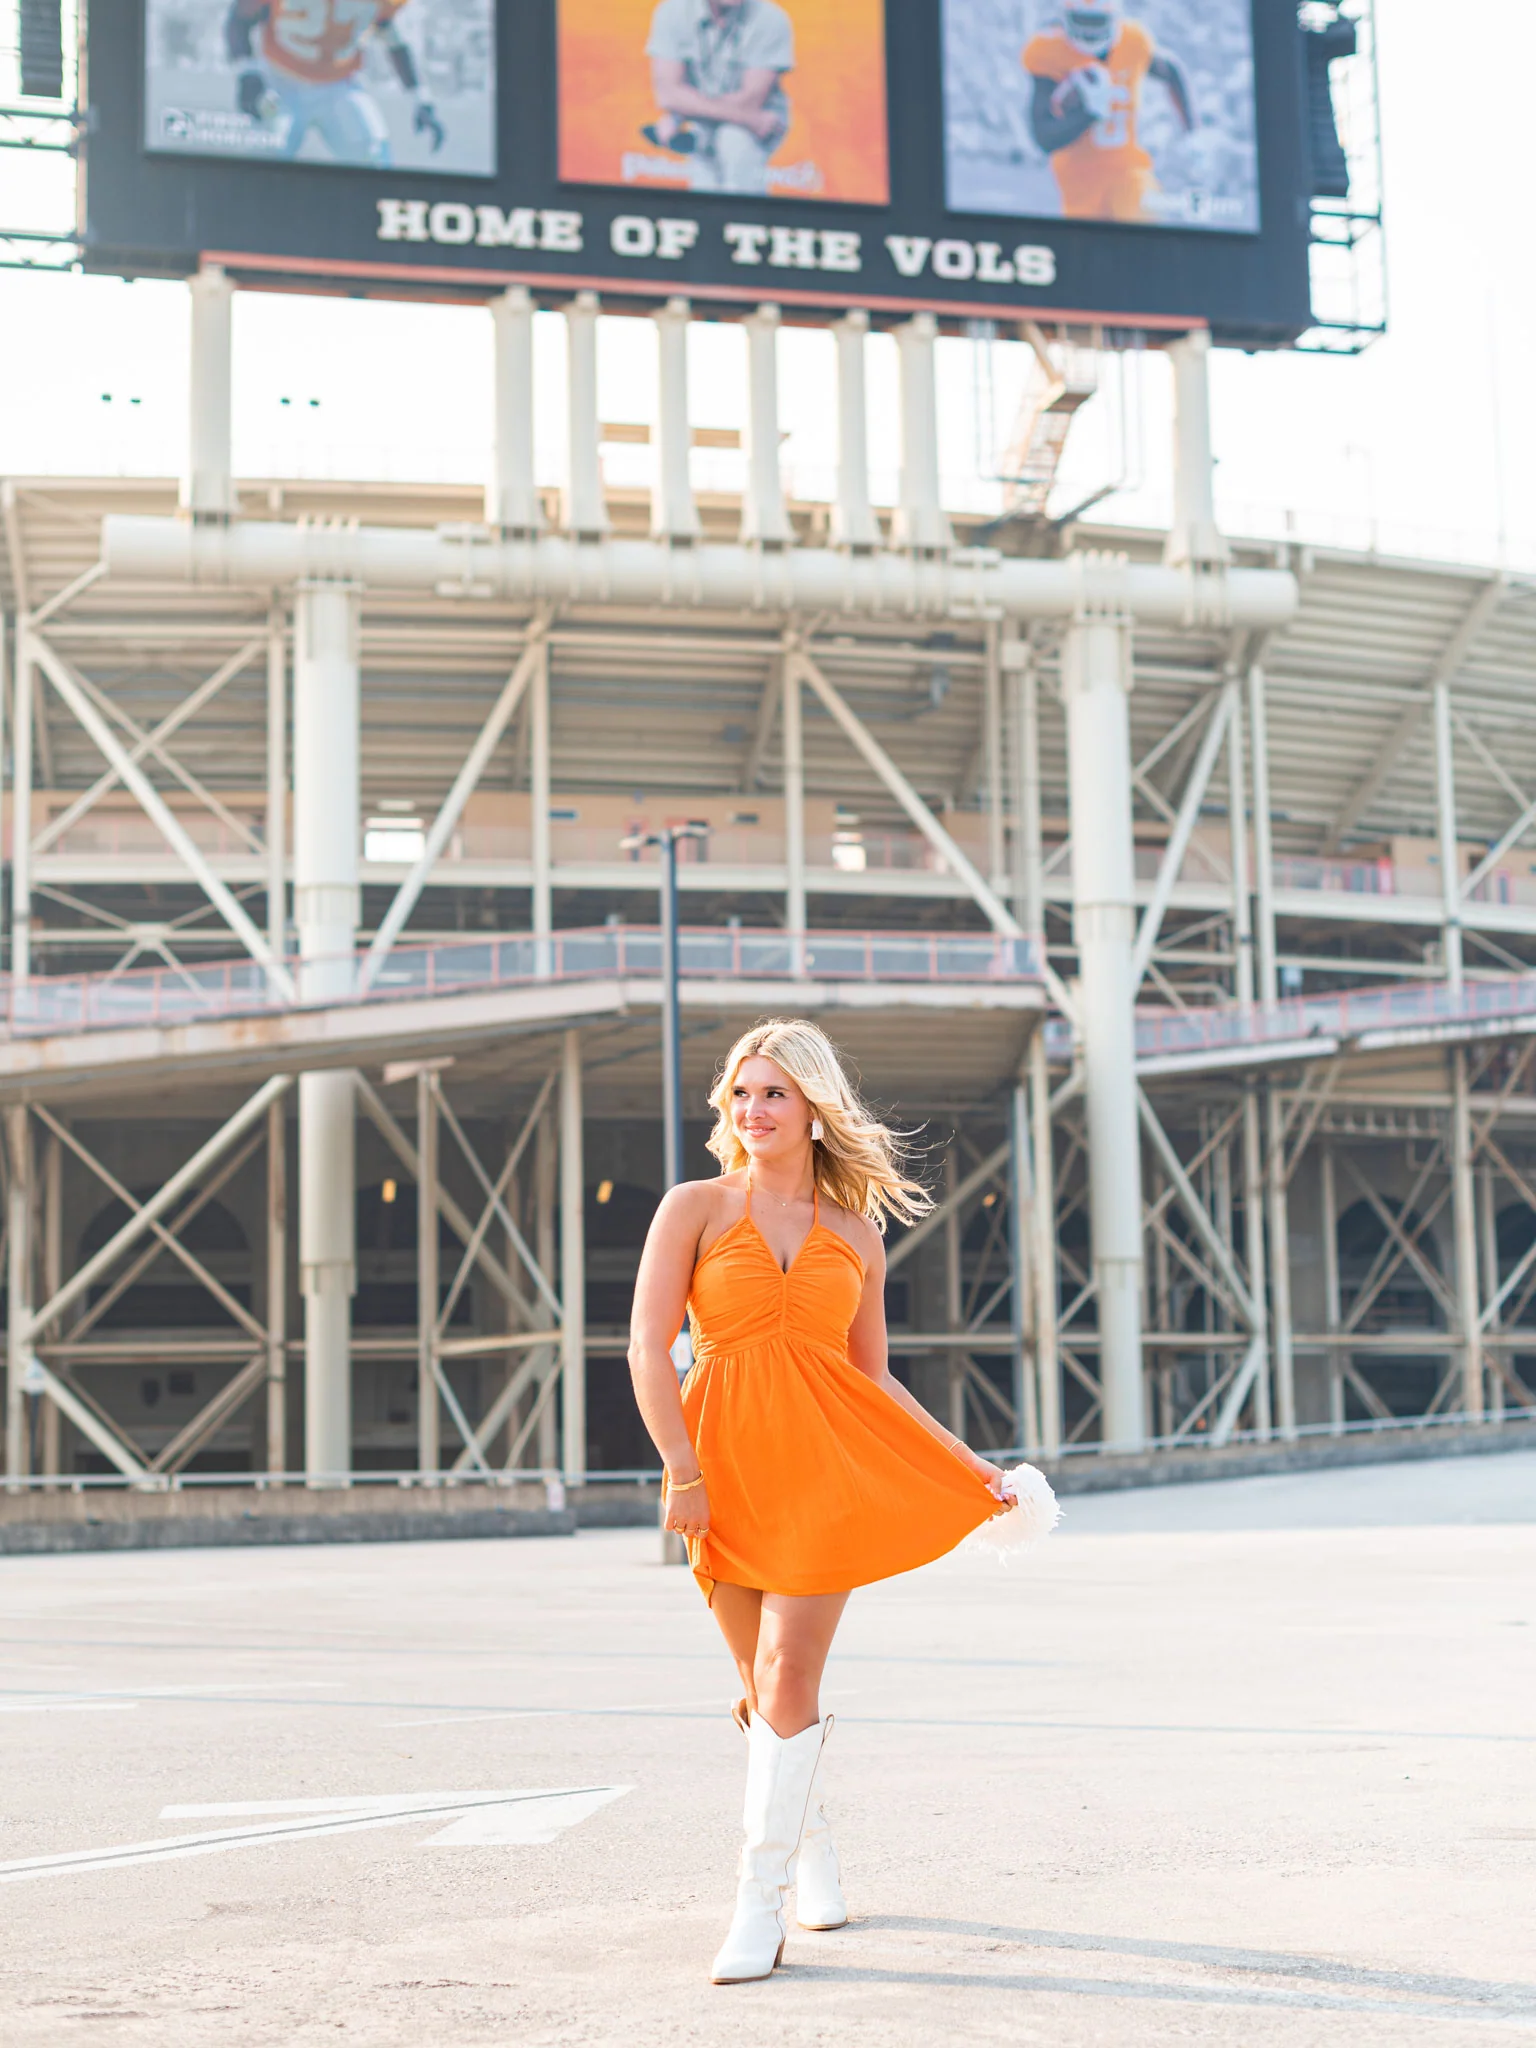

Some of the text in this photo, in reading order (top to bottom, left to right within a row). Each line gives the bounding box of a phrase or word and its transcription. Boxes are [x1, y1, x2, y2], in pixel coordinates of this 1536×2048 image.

[377, 199, 1057, 286] HOME OF THE VOLS
